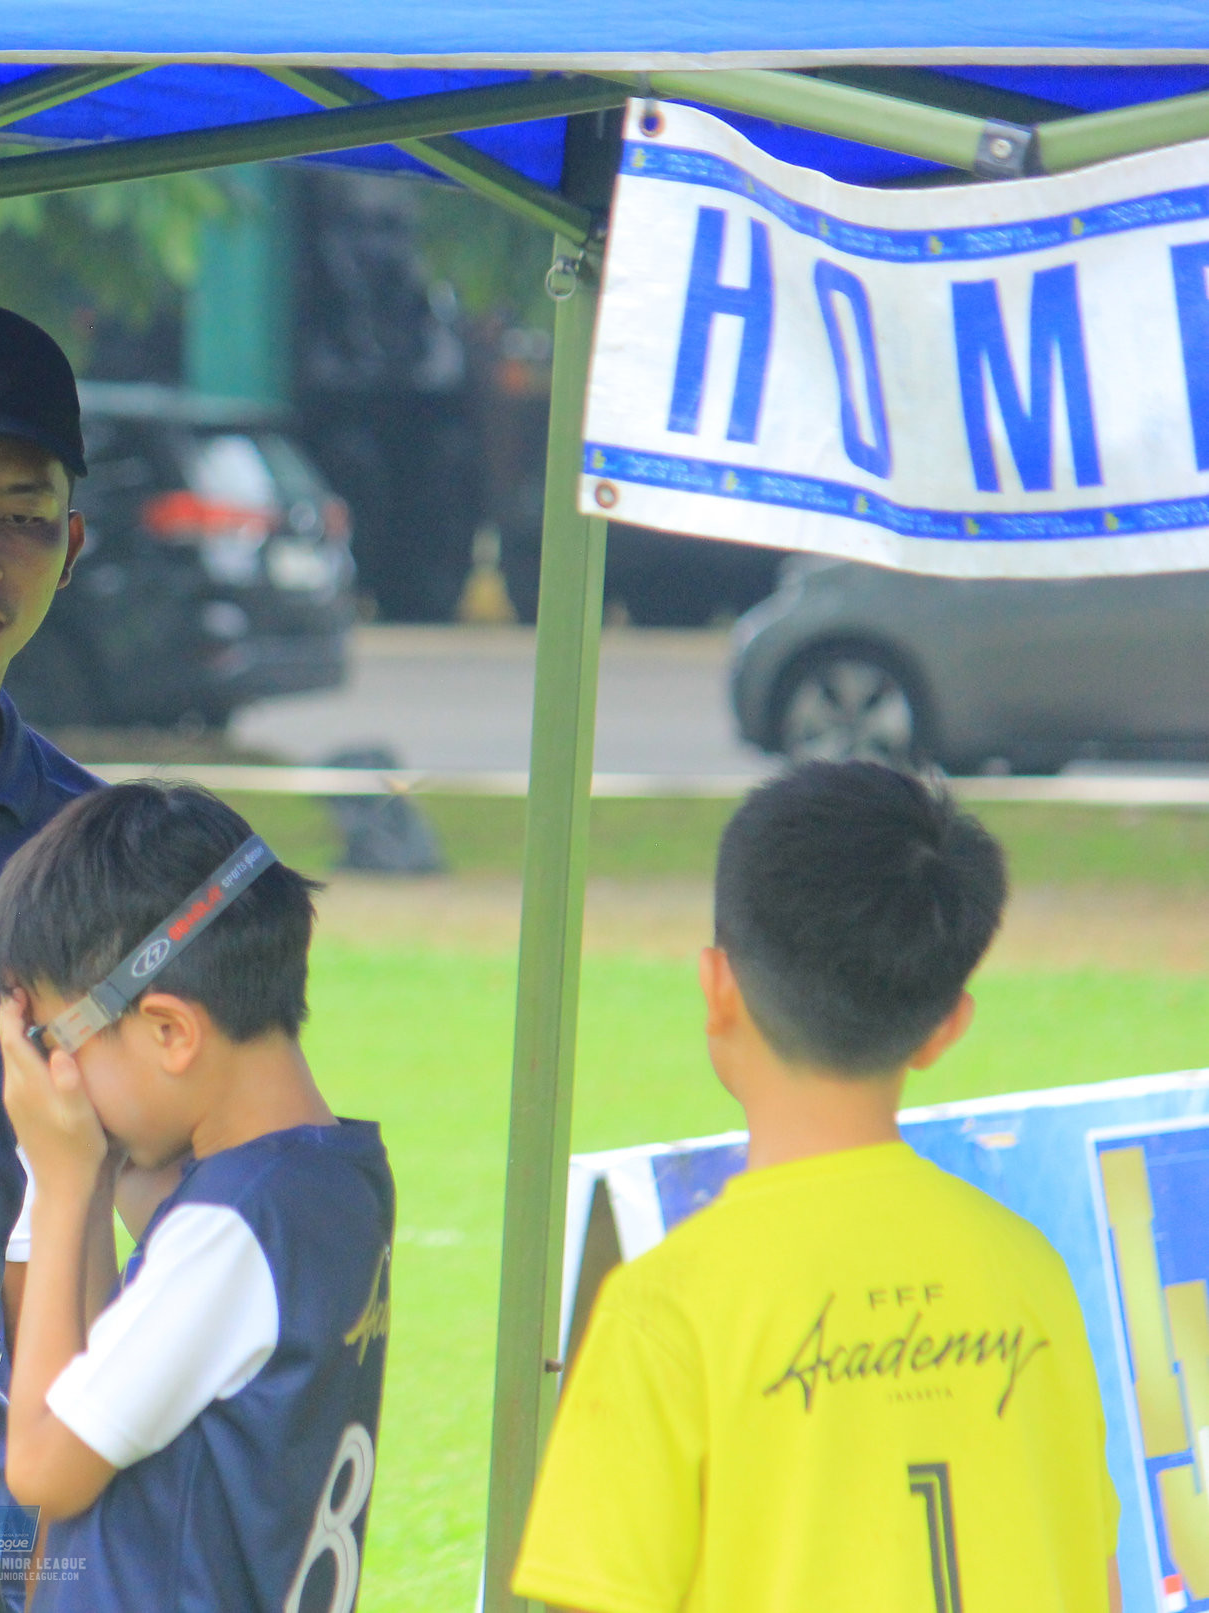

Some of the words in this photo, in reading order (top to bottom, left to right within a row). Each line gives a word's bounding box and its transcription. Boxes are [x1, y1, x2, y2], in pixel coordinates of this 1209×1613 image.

[762, 1292, 1049, 1419] Academy
[285, 1423, 375, 1613] 8
[907, 1463, 964, 1613] 1
